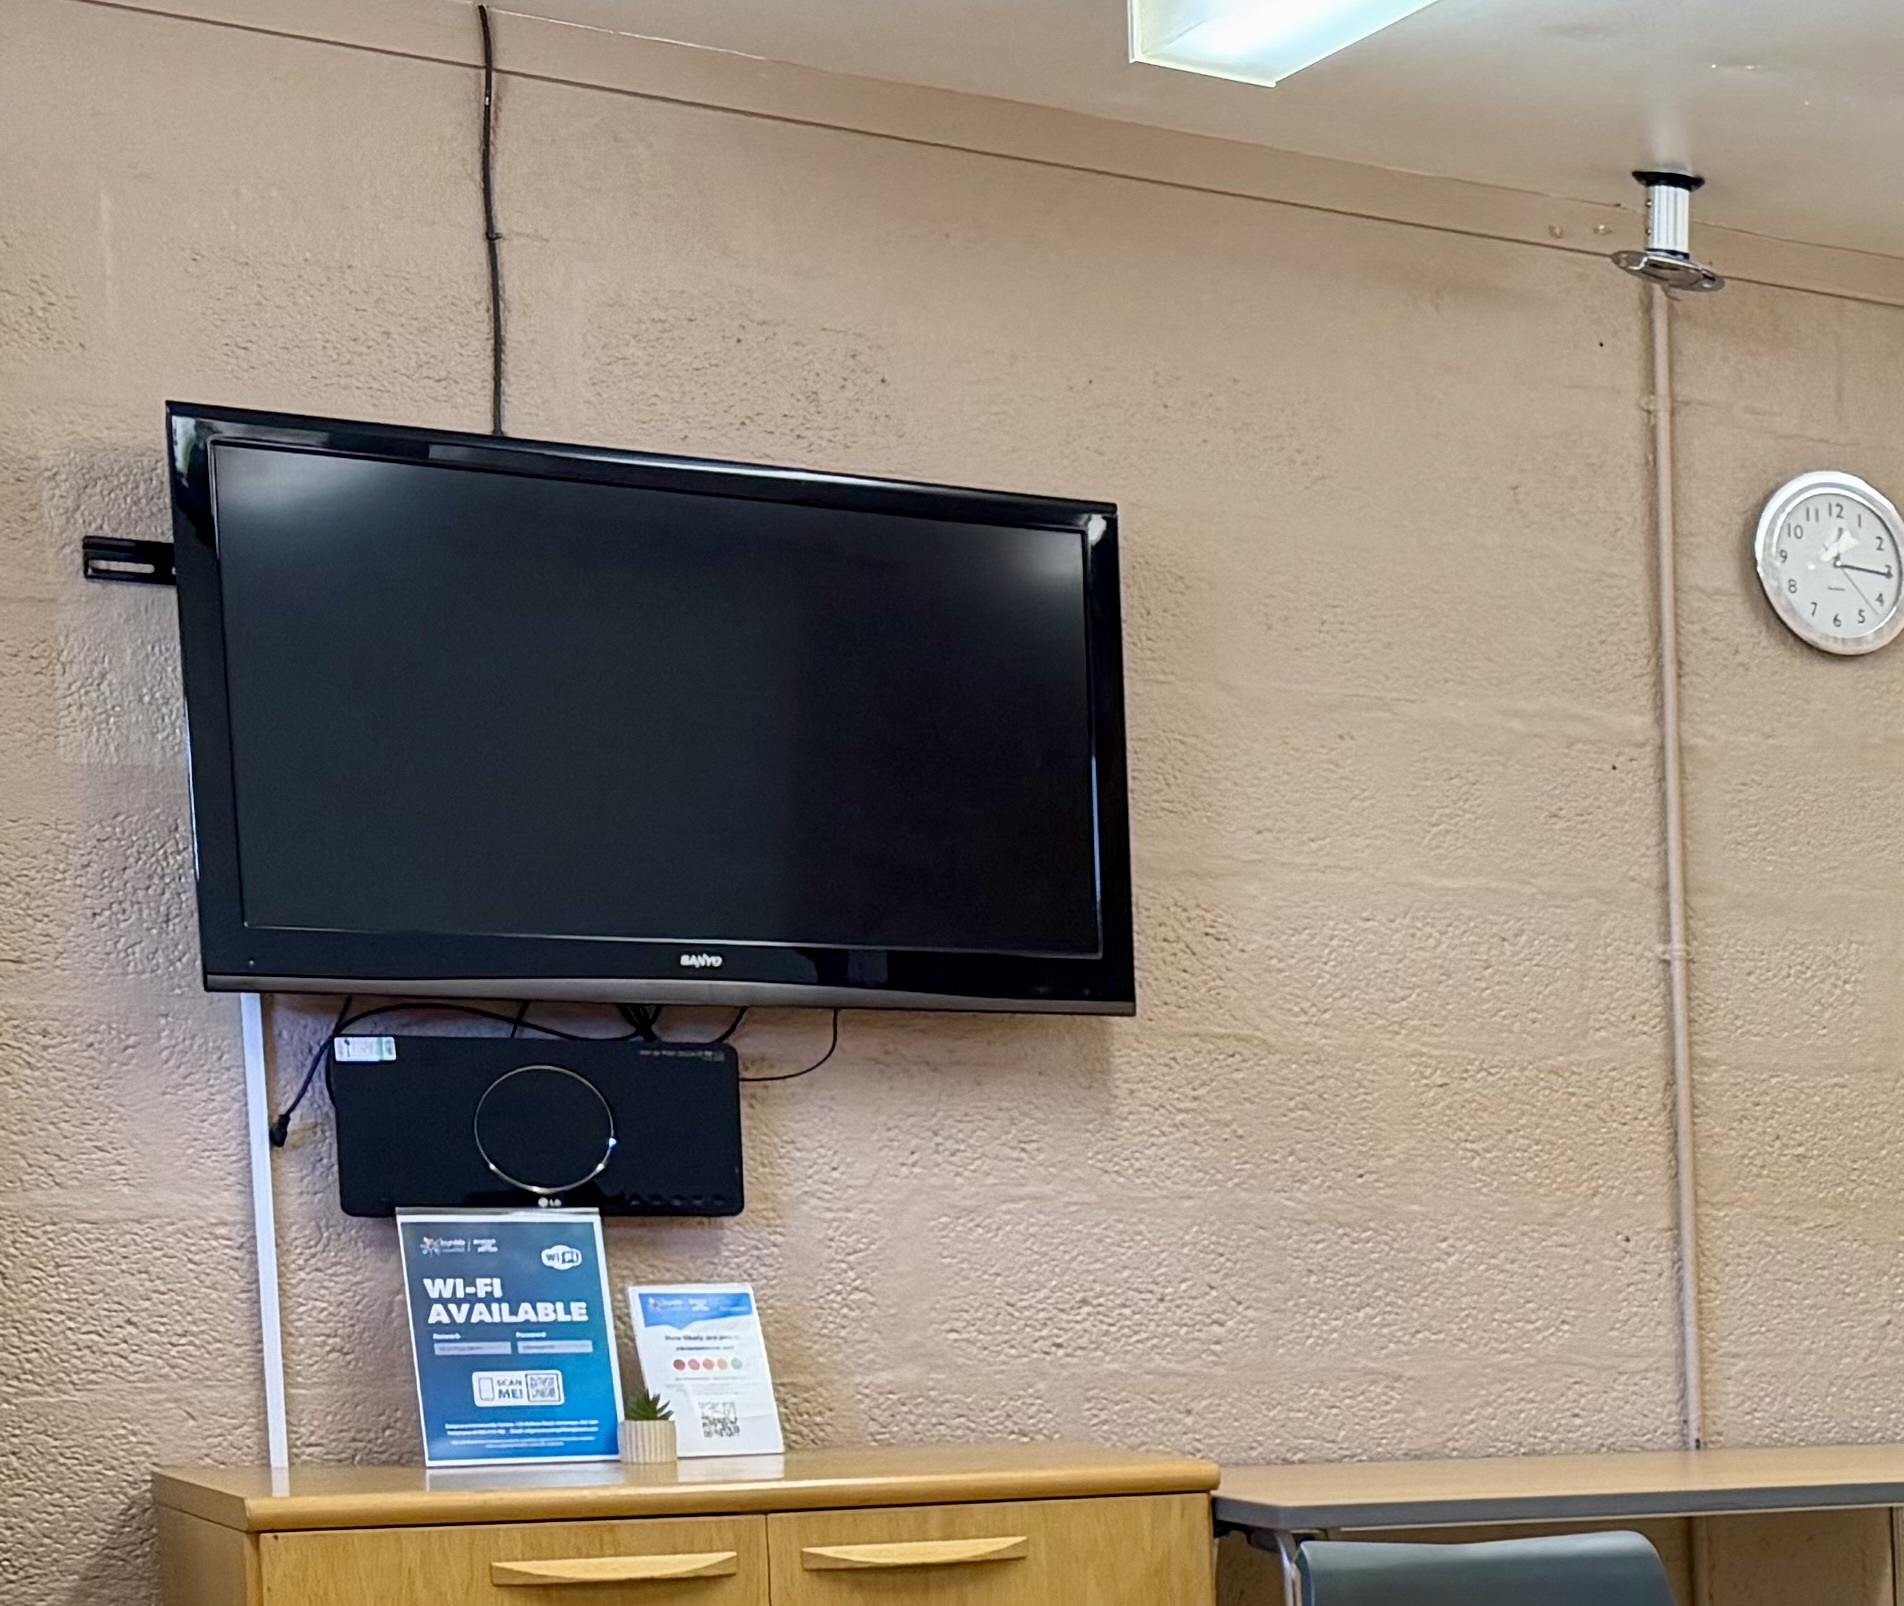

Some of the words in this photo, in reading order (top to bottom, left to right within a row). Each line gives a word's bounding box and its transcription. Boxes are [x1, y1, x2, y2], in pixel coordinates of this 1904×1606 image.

[1806, 507, 1820, 522] 11
[1828, 502, 1844, 519] 12
[1787, 523, 1804, 539] 10
[1875, 536, 1884, 551] 2
[1780, 549, 1788, 563] 9
[1788, 578, 1798, 594] 8
[1875, 592, 1884, 607] 4
[1810, 601, 1818, 617] 7
[1858, 609, 1866, 624] 5
[1833, 613, 1841, 627] 6
[423, 1278, 502, 1298] WI-FI
[427, 1301, 589, 1324] AVAILABLE
